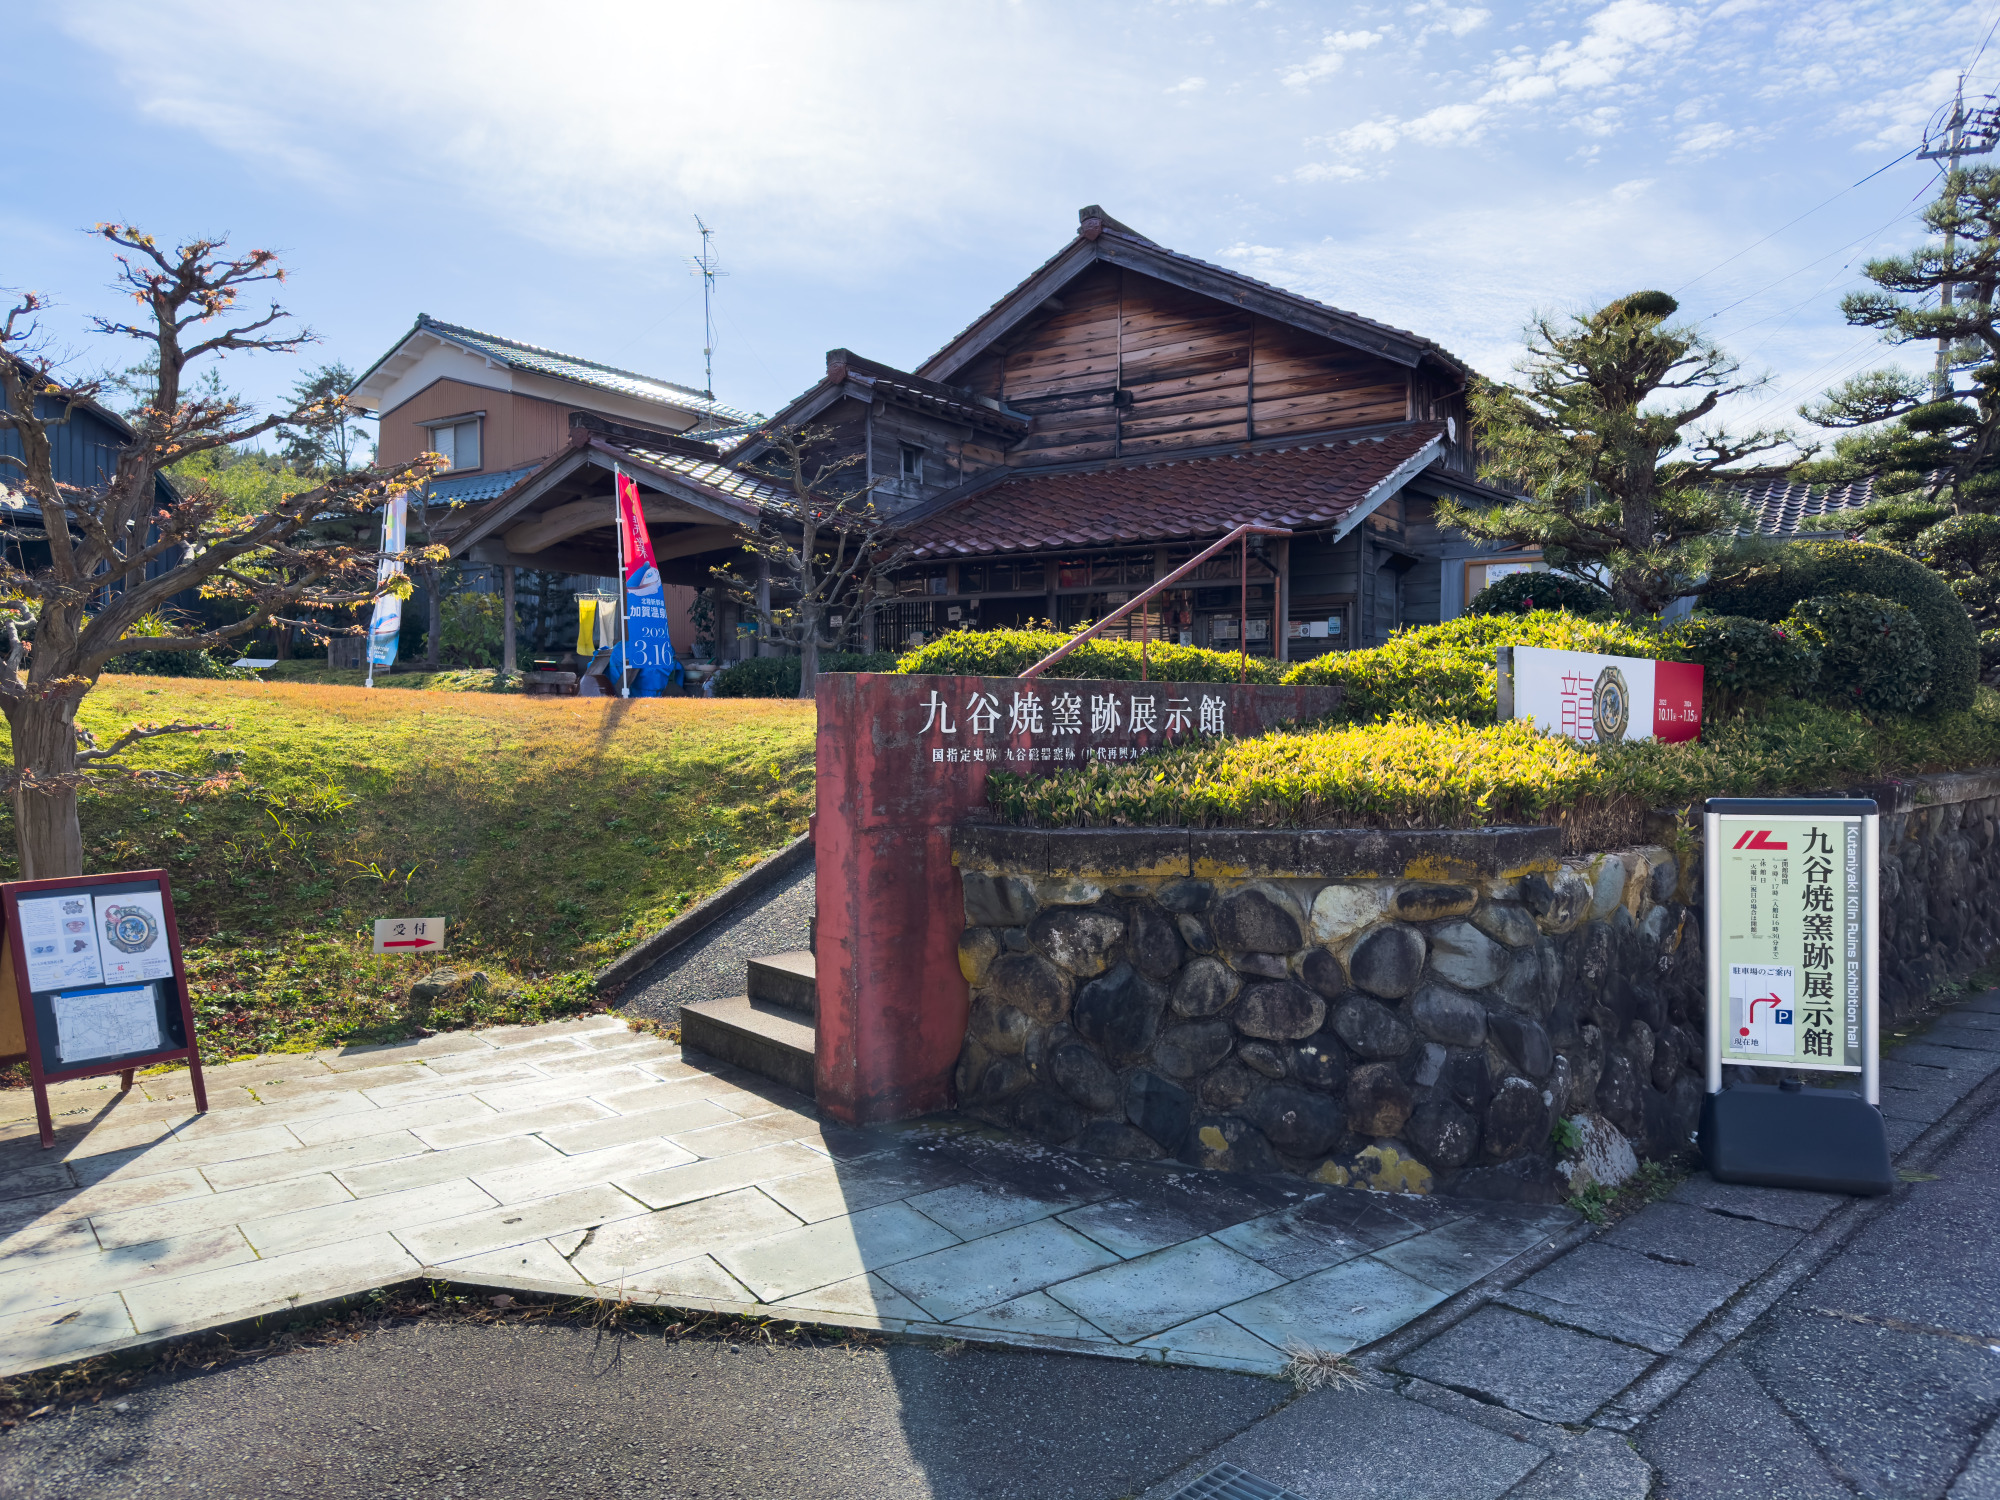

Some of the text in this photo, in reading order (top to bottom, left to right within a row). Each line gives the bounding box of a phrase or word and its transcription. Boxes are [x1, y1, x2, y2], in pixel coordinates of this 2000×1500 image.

[632, 640, 672, 666] 3.16
[918, 690, 1225, 736] 九谷焼窯跡展示館
[932, 748, 997, 762] 国指定史跡
[393, 922, 427, 936] 受付
[1801, 826, 1834, 1057] 九谷焼窯跡展示館
[1846, 826, 1859, 1048] Kutaniyaki Kiln Ruins Exhibition hall
[1732, 966, 1792, 977] 駐車場のご案内
[1778, 1011, 1789, 1023] P
[1733, 1037, 1759, 1047] 現在地
